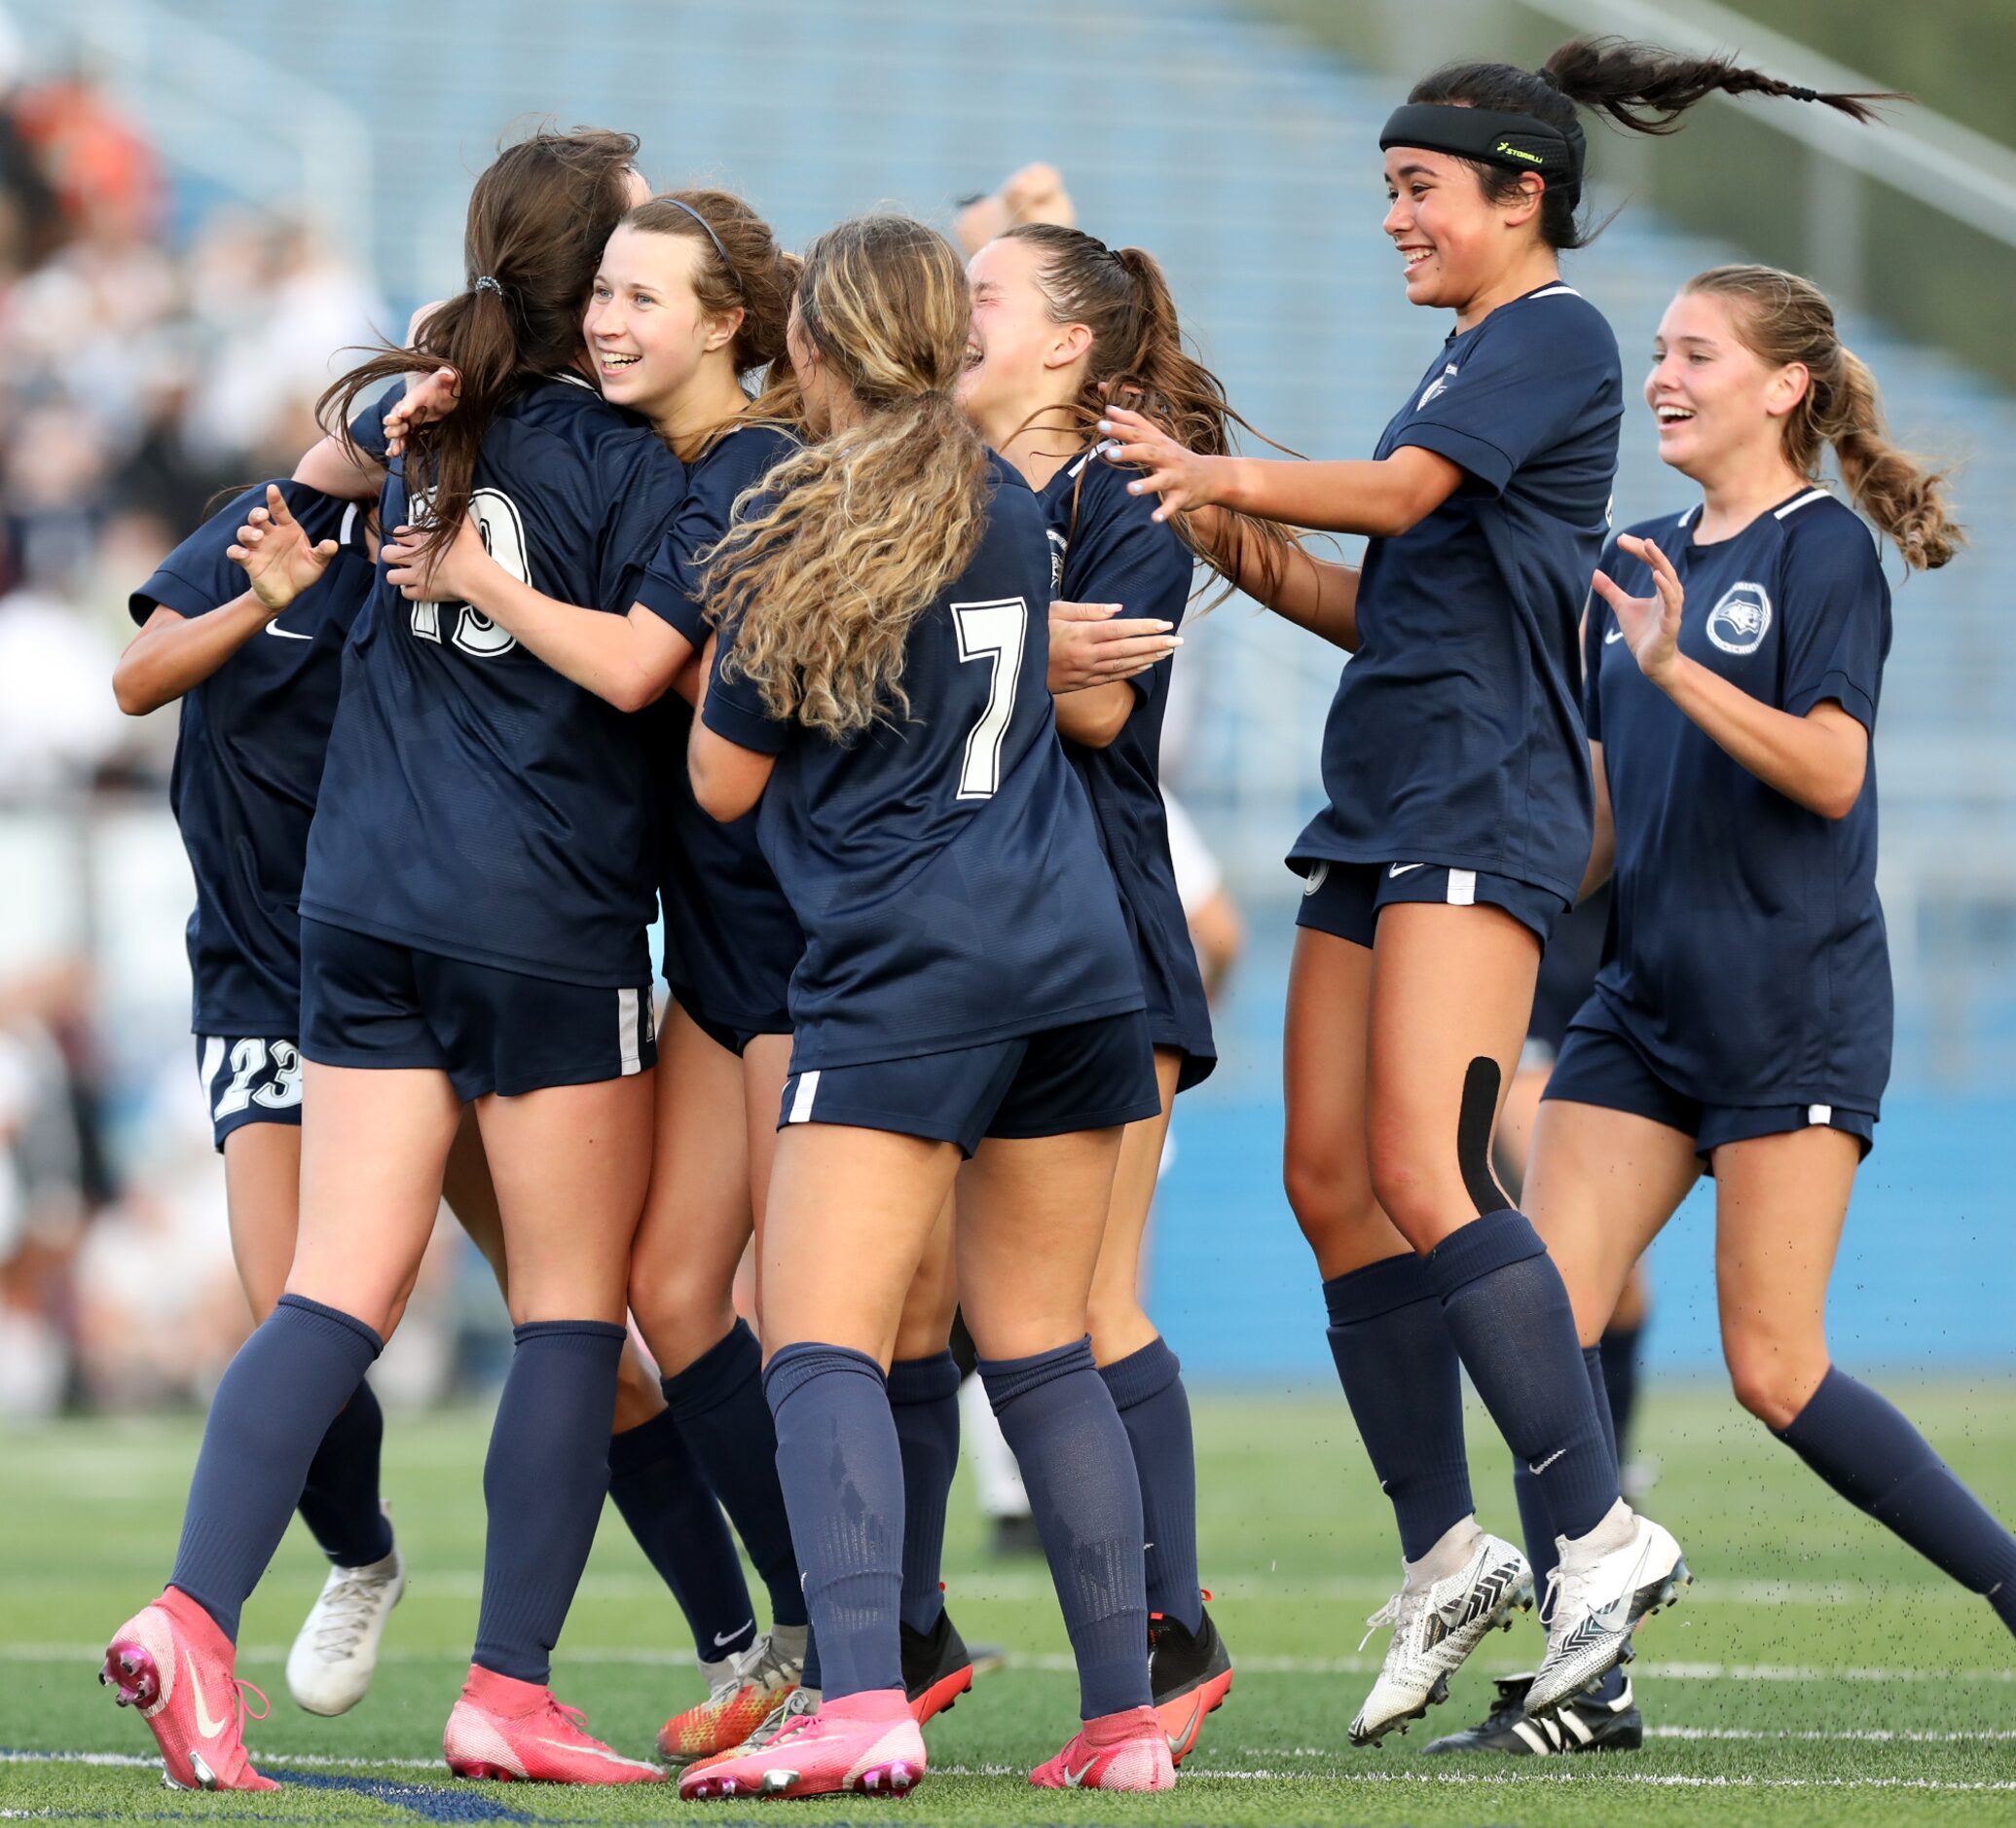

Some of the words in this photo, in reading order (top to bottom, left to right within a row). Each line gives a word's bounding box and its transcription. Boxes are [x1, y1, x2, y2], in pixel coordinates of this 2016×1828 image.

[1505, 148, 1544, 164] STORELLI
[950, 596, 1028, 800] 7
[214, 1037, 304, 1122] 23
